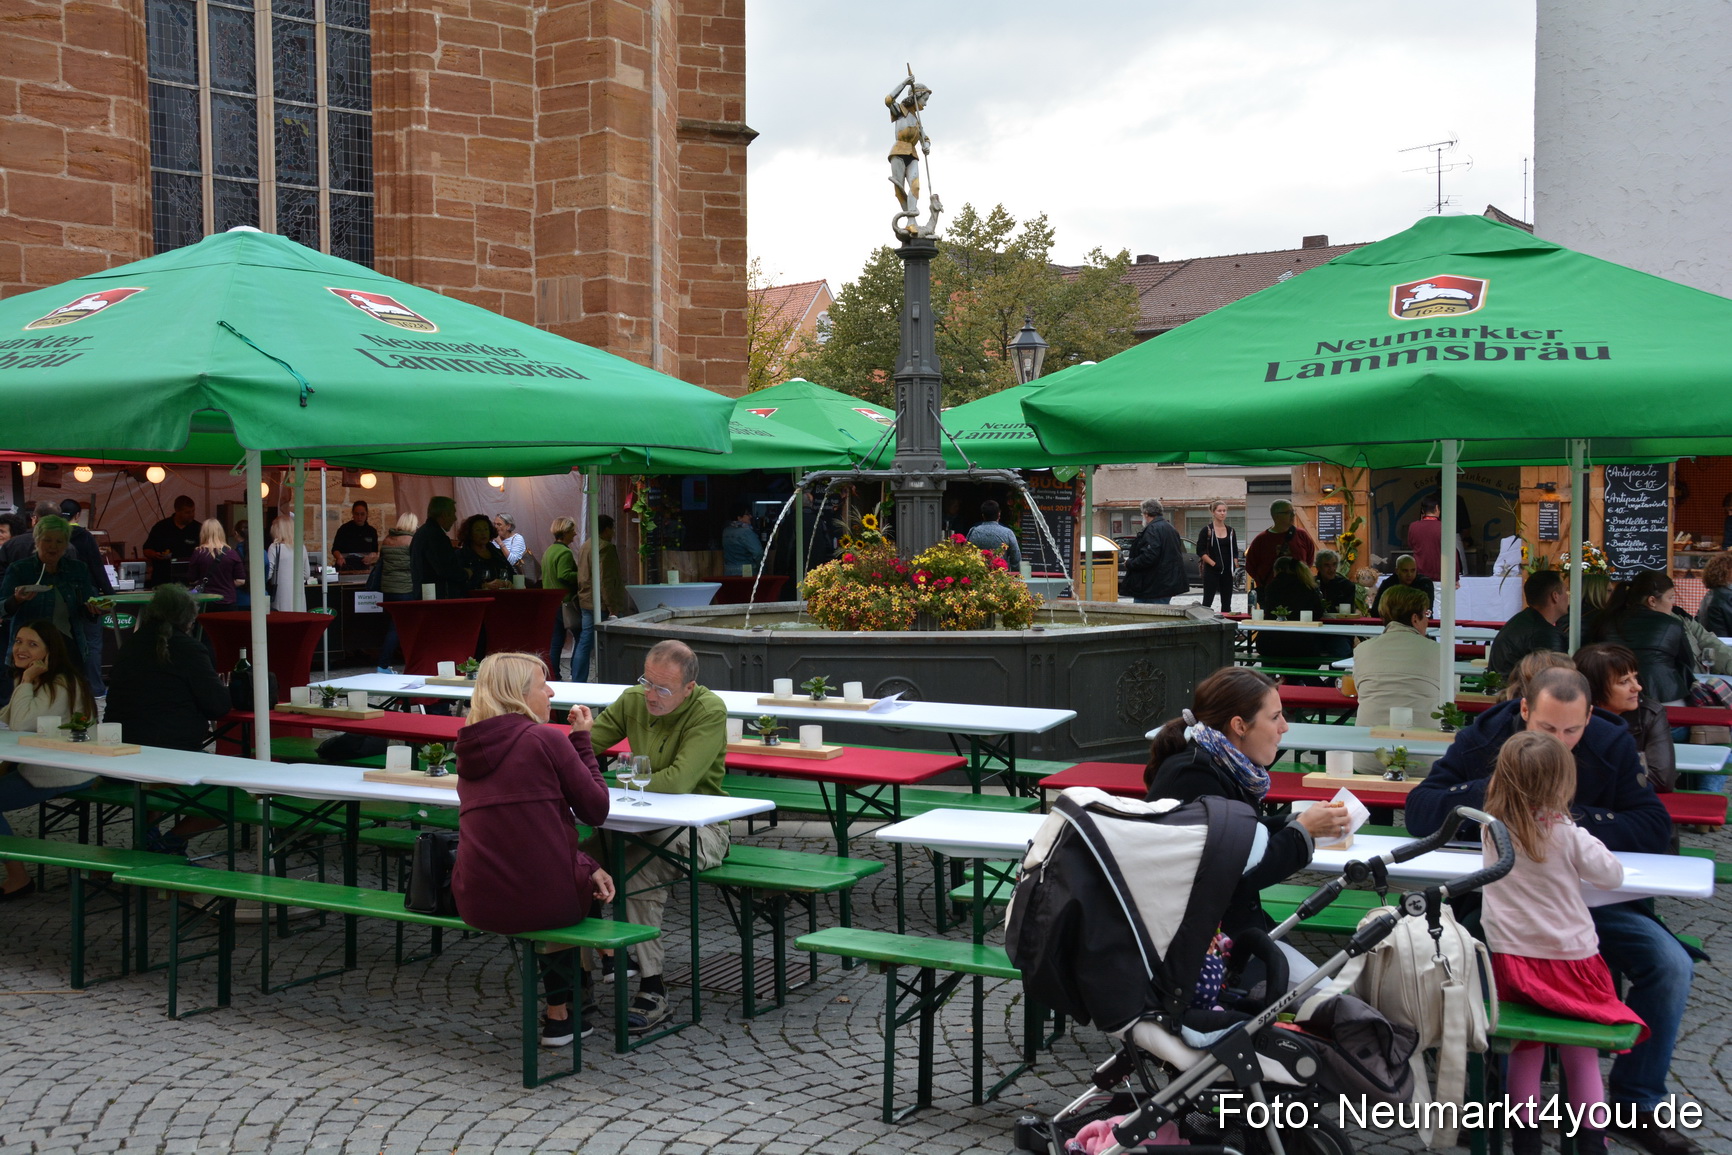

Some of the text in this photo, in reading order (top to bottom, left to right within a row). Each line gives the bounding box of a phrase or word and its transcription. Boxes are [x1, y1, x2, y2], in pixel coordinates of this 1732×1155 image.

[1414, 305, 1457, 318] 1628
[397, 320, 429, 331] 1628
[360, 333, 528, 359] Neumarkter
[1313, 325, 1564, 356] Neumarkter
[0, 349, 84, 370] bräu
[354, 347, 591, 381] Lammsbräu
[1263, 341, 1612, 383] Lammsbräu
[980, 422, 1029, 430] Neum
[953, 430, 1038, 440] Lamms
[1610, 464, 1660, 483] Antipasto
[1608, 491, 1651, 506] Antipasto
[1650, 516, 1666, 525] mit
[1617, 553, 1643, 566] Pfand
[1257, 989, 1298, 1025] sprint
